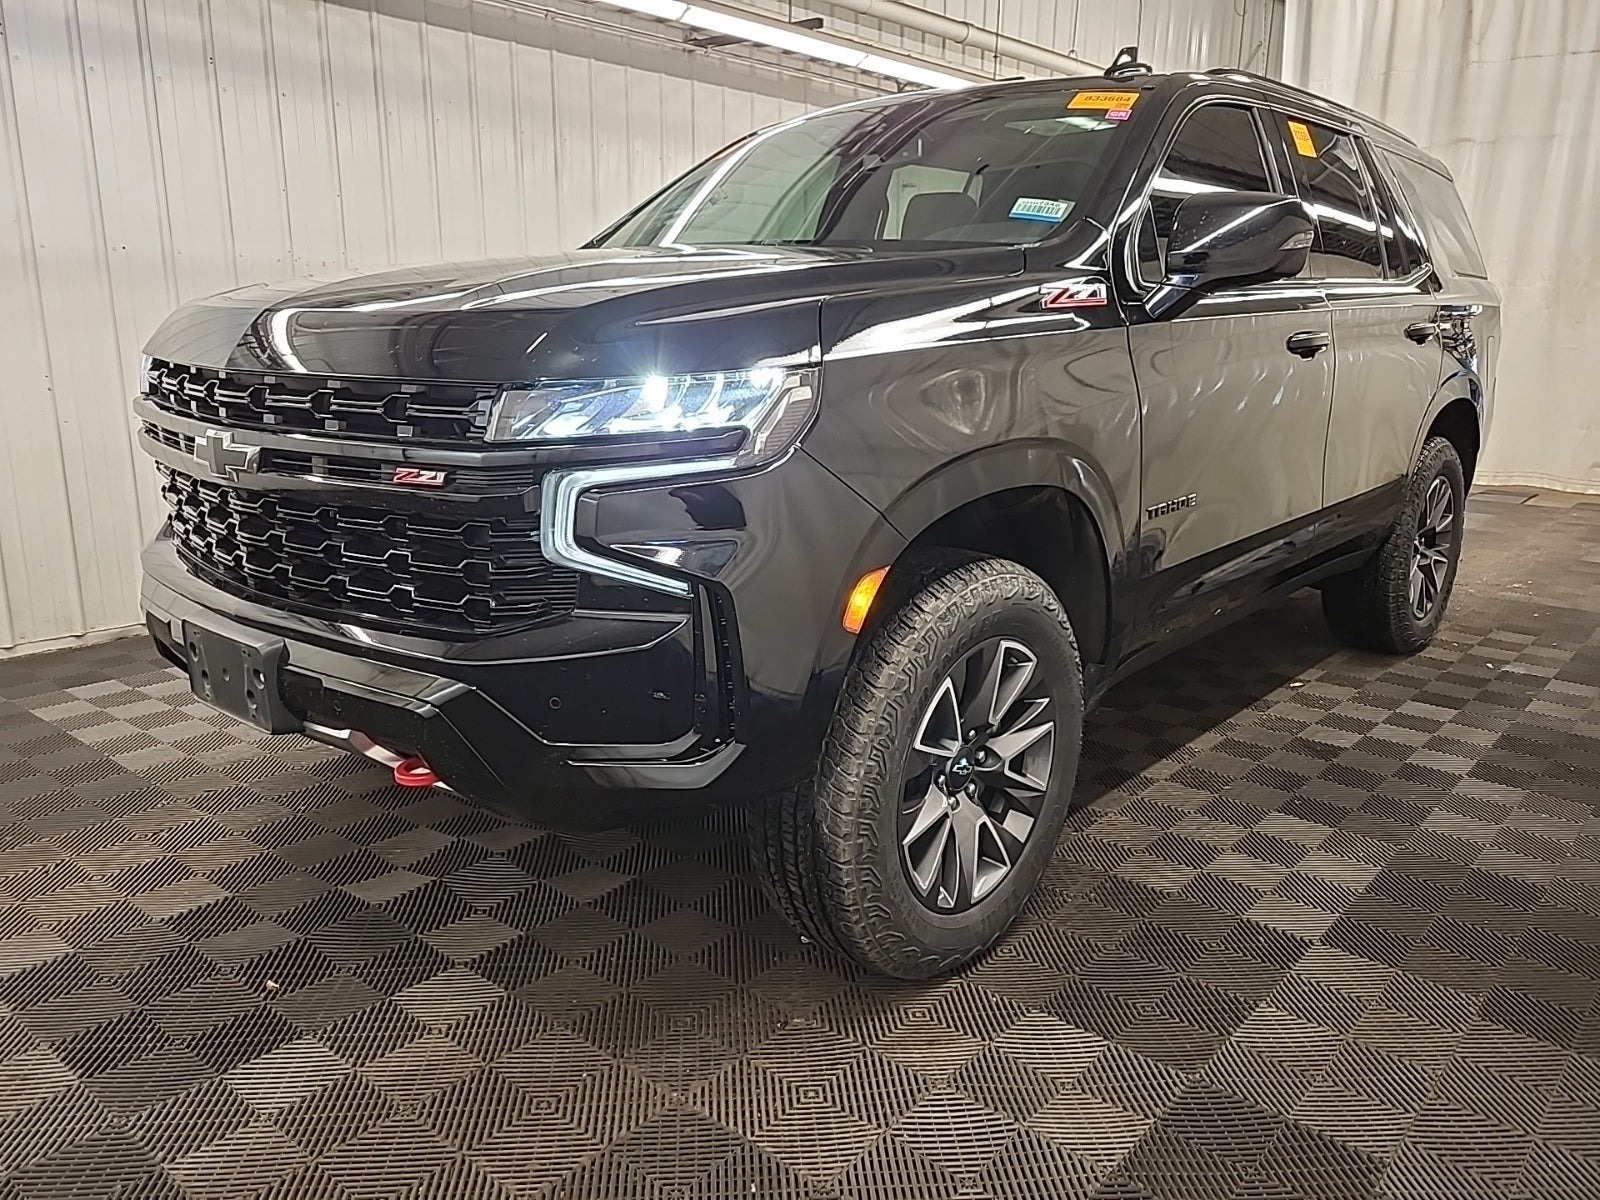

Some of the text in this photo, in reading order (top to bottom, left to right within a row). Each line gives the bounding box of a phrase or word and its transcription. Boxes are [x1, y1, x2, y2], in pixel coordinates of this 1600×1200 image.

[1040, 283, 1108, 309] Z71
[393, 467, 448, 486] Z71
[1146, 493, 1197, 520] TAHOE
